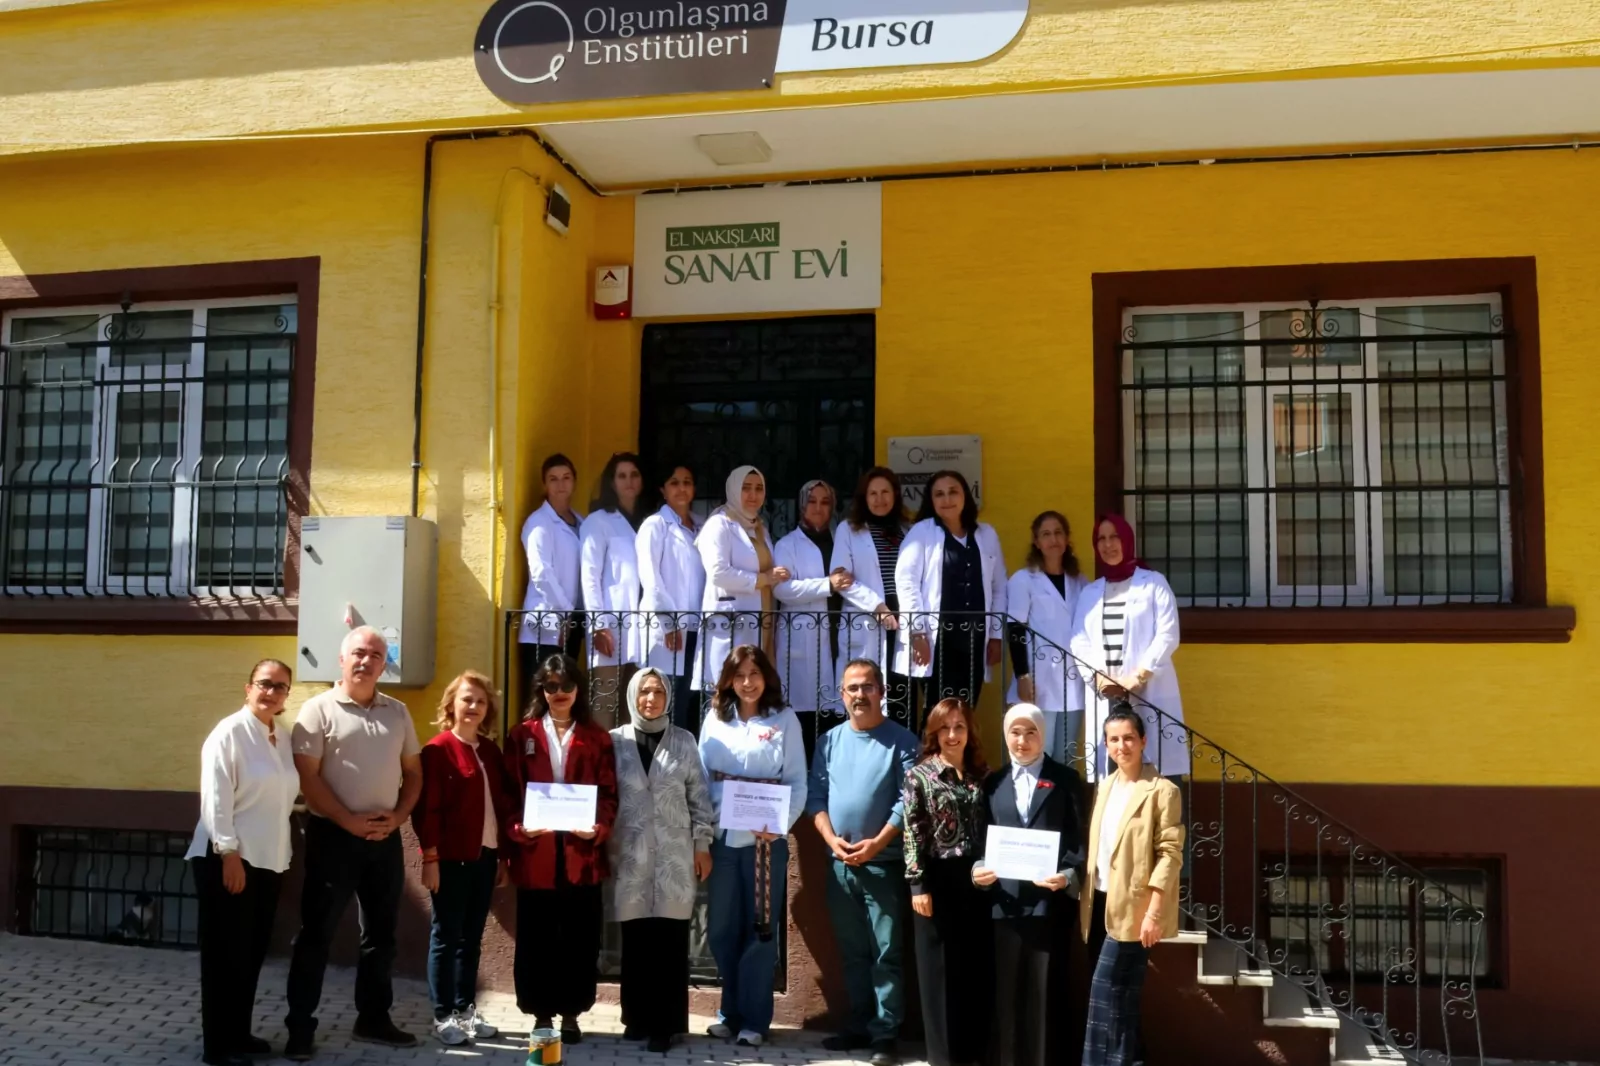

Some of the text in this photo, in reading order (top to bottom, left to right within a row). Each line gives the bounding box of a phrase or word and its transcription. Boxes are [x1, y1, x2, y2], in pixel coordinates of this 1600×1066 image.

[584, 1, 768, 38] Olgunlaşma
[811, 17, 934, 51] Bursa
[582, 29, 748, 65] Enstitüleri
[669, 227, 775, 248] EL NAKIŞLARI
[664, 239, 849, 285] SANAT EVİ
